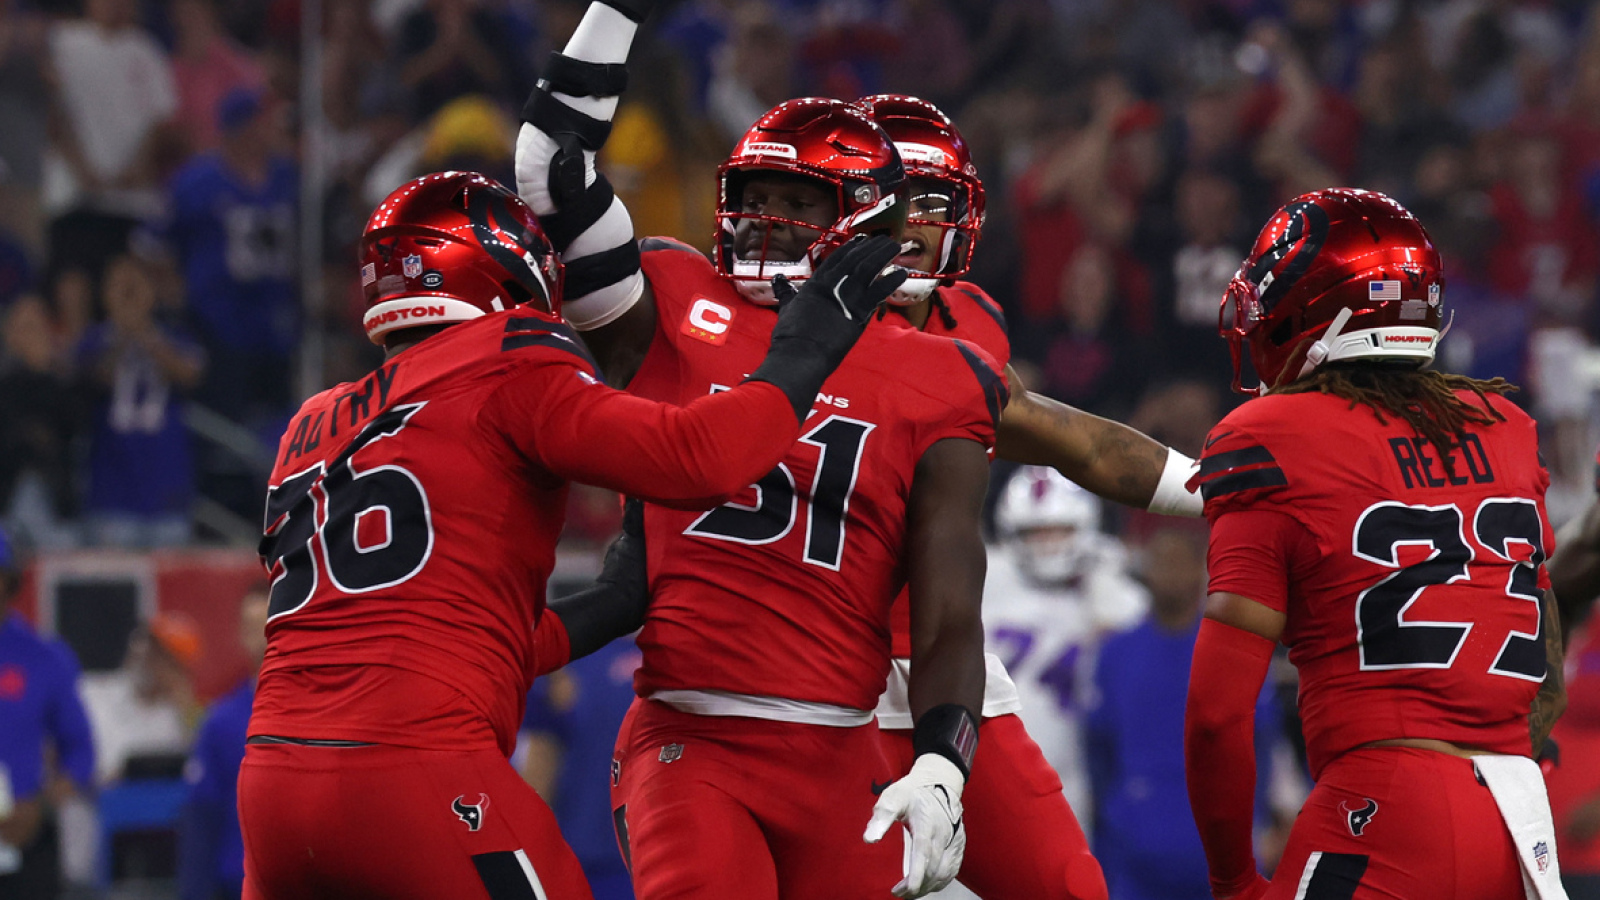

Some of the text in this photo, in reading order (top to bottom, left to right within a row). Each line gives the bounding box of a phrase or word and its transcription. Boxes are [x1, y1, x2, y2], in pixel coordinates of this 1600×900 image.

[749, 144, 789, 153] TEXANS
[689, 298, 732, 335] C
[283, 364, 398, 466] AUTRY
[1388, 433, 1495, 489] REED
[1352, 497, 1547, 682] 23
